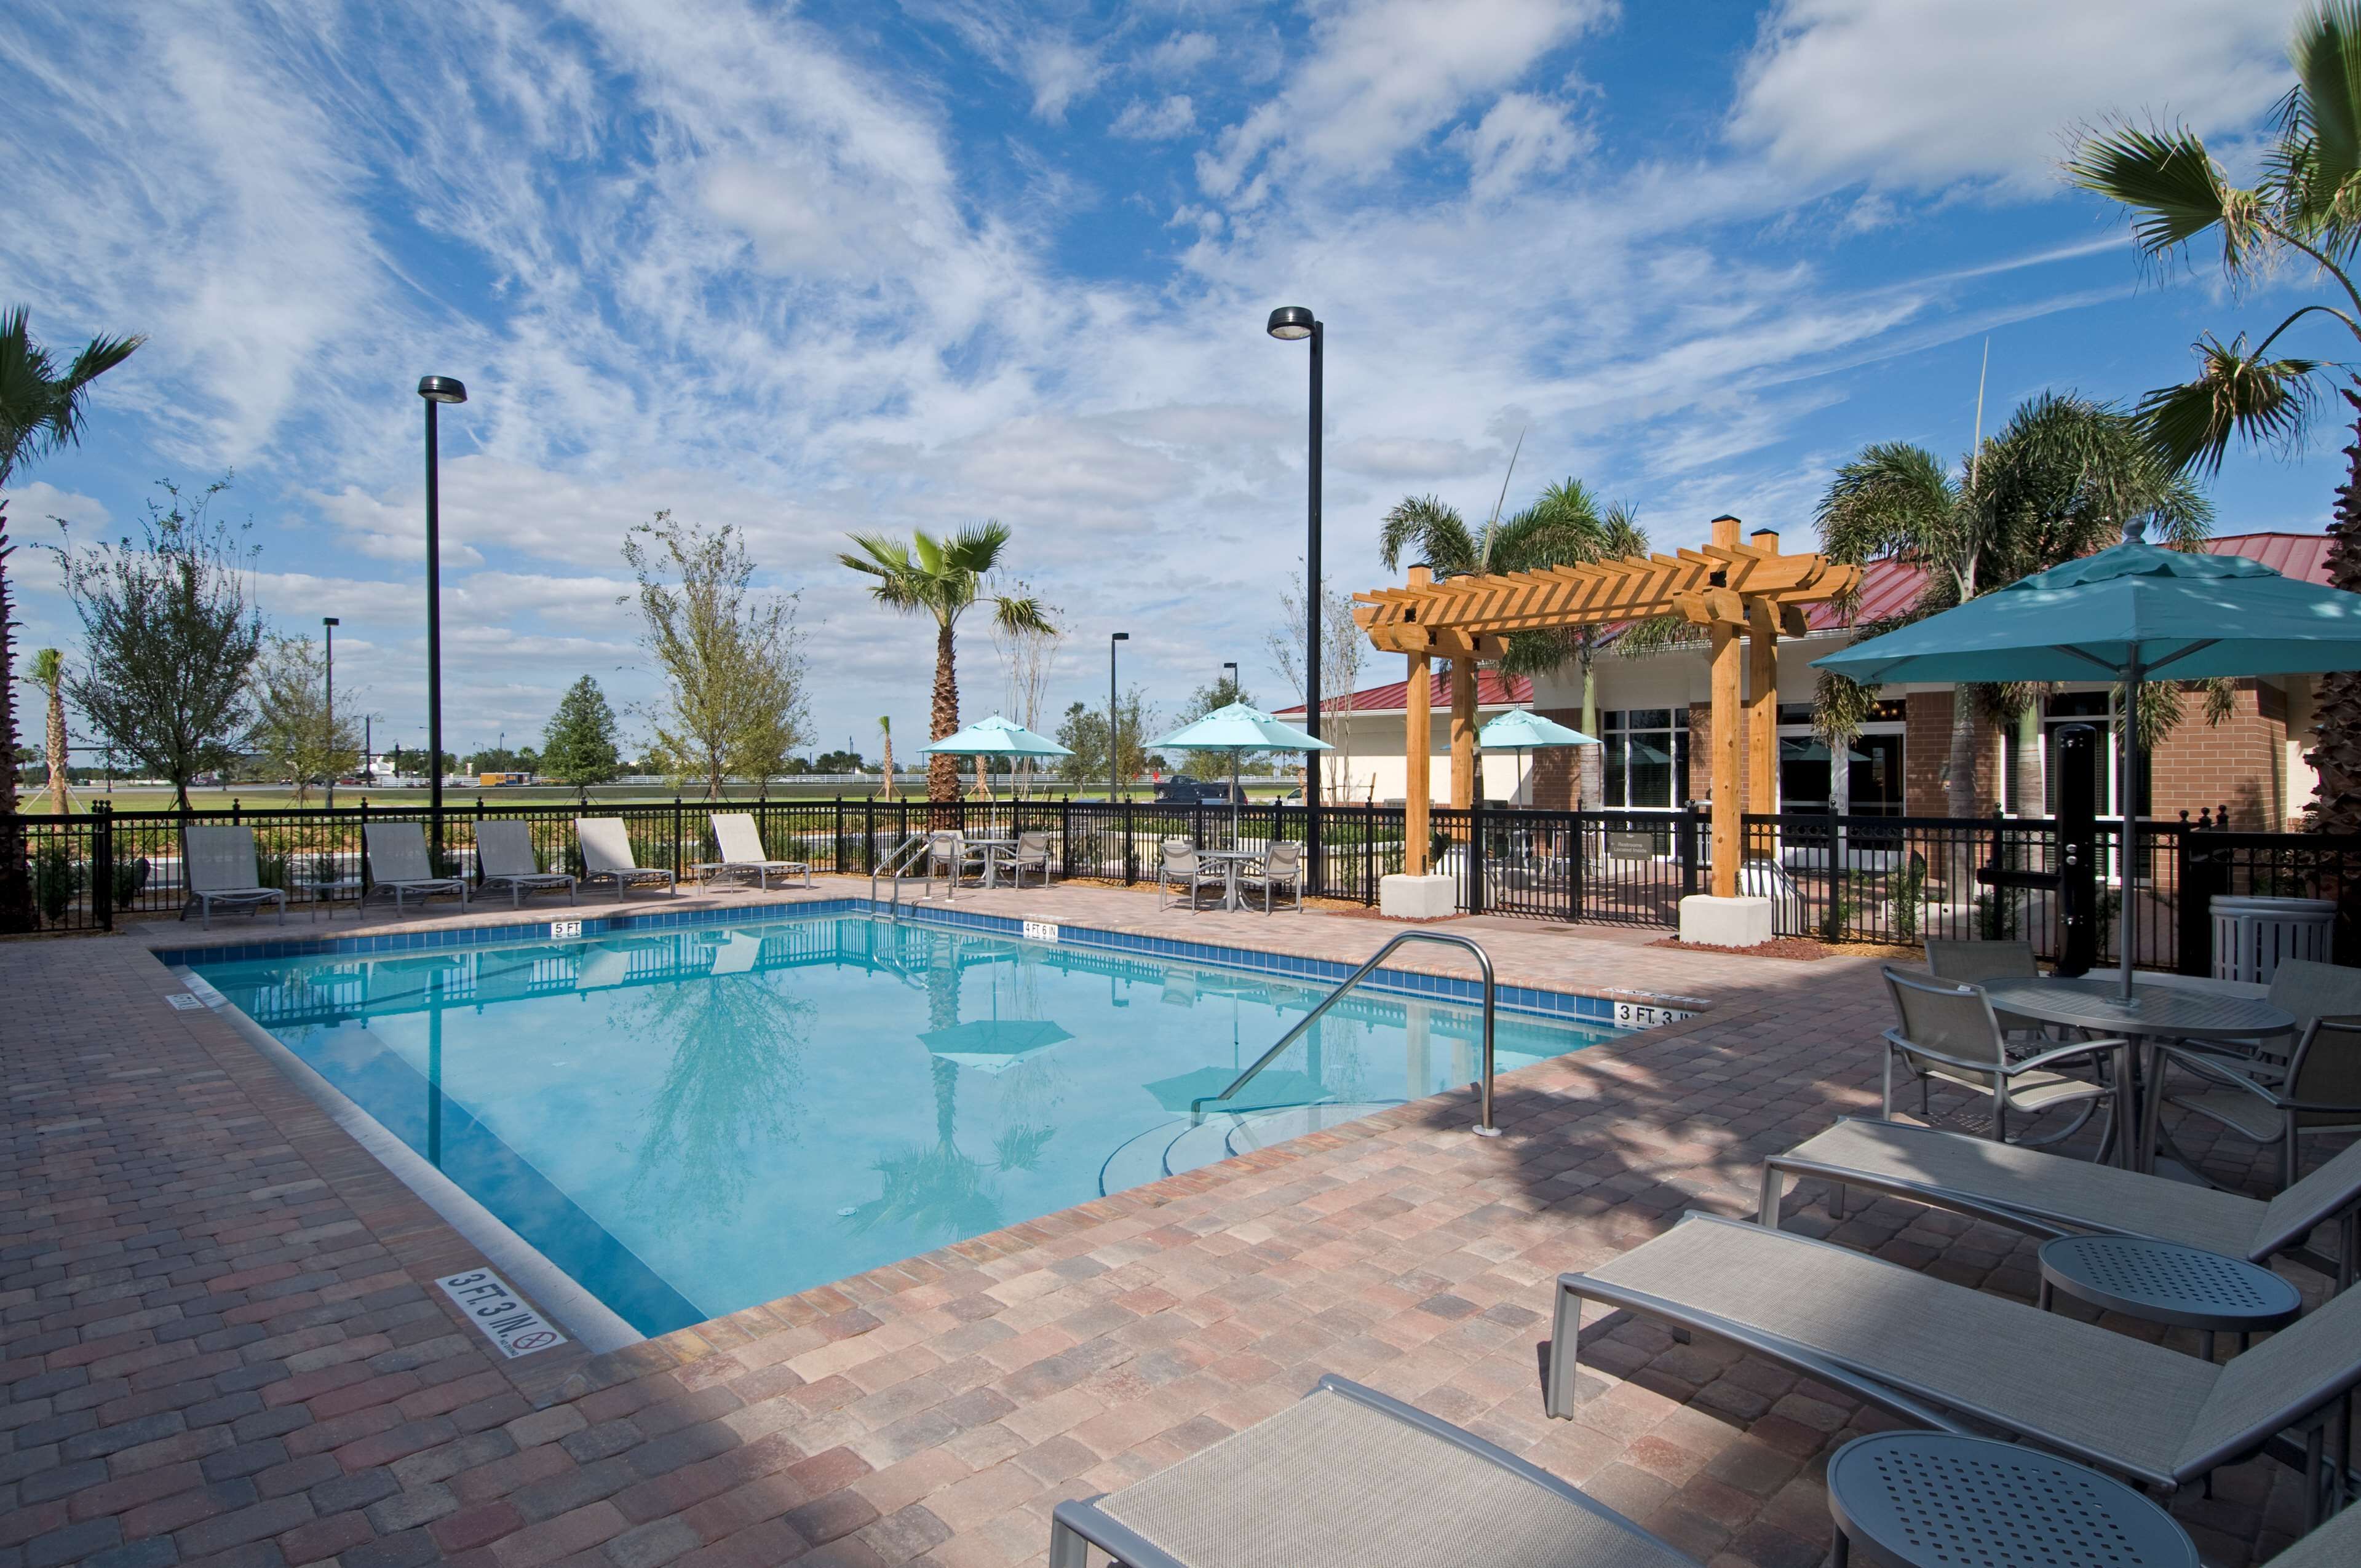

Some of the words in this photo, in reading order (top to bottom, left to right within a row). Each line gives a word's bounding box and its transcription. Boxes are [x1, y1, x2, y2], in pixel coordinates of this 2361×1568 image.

[555, 923, 563, 933] 5
[1025, 923, 1030, 933] 4
[1042, 925, 1047, 935] 6
[1620, 1005, 1630, 1020] 3
[1662, 1011, 1673, 1025] 3
[448, 1273, 486, 1286] 3
[458, 1283, 508, 1305] FT.
[477, 1302, 517, 1317] 3
[488, 1313, 538, 1338] IN.
[500, 1339, 511, 1348] NO
